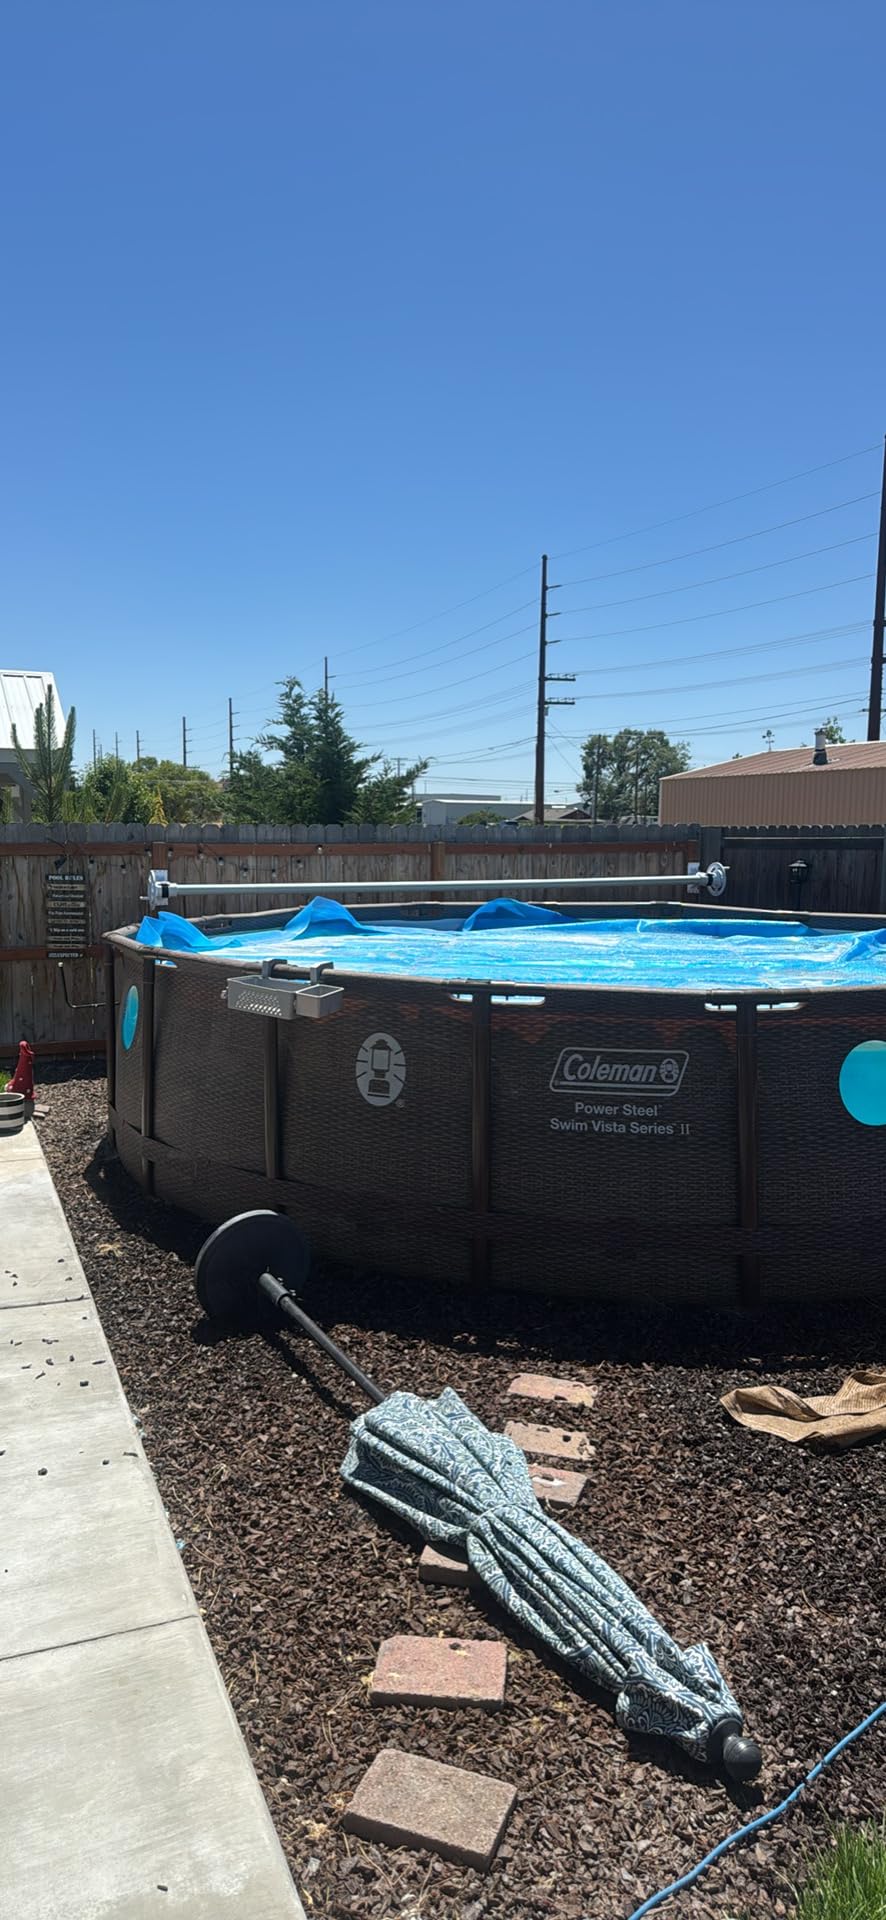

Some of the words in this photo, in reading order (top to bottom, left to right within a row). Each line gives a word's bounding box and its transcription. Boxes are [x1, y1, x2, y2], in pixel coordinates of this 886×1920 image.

[563, 1054, 657, 1082] Coleman
[575, 1102, 619, 1115] Power
[550, 1118, 588, 1131] Swim
[591, 1120, 626, 1133] Vista
[680, 1123, 690, 1135] II
